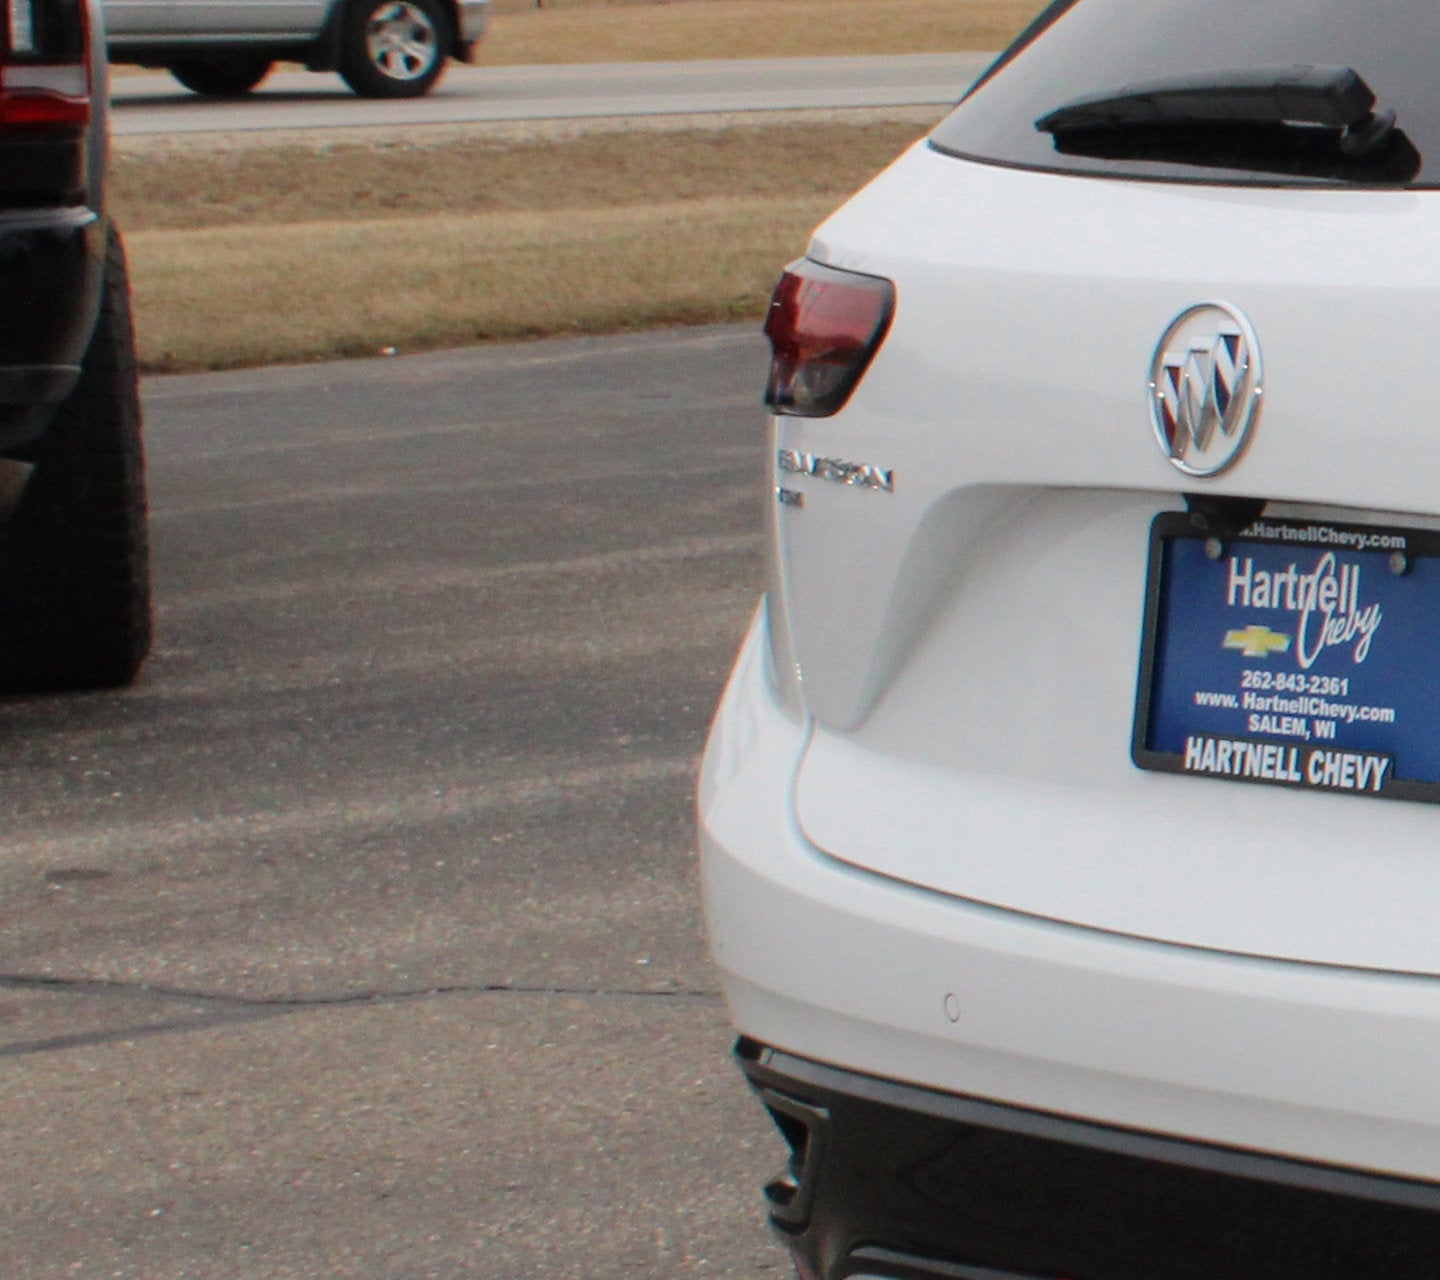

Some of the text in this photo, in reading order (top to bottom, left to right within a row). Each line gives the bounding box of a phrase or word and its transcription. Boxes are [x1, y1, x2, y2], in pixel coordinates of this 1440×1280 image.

[1226, 556, 1361, 613] Hartnell
[1296, 550, 1384, 670] Chevy
[1240, 669, 1350, 697] 262-843-2361
[1242, 691, 1396, 723] HartnellChevy.com
[1248, 713, 1337, 741] SALEM, WI
[1184, 735, 1390, 792] HARTNELL CHEVY
